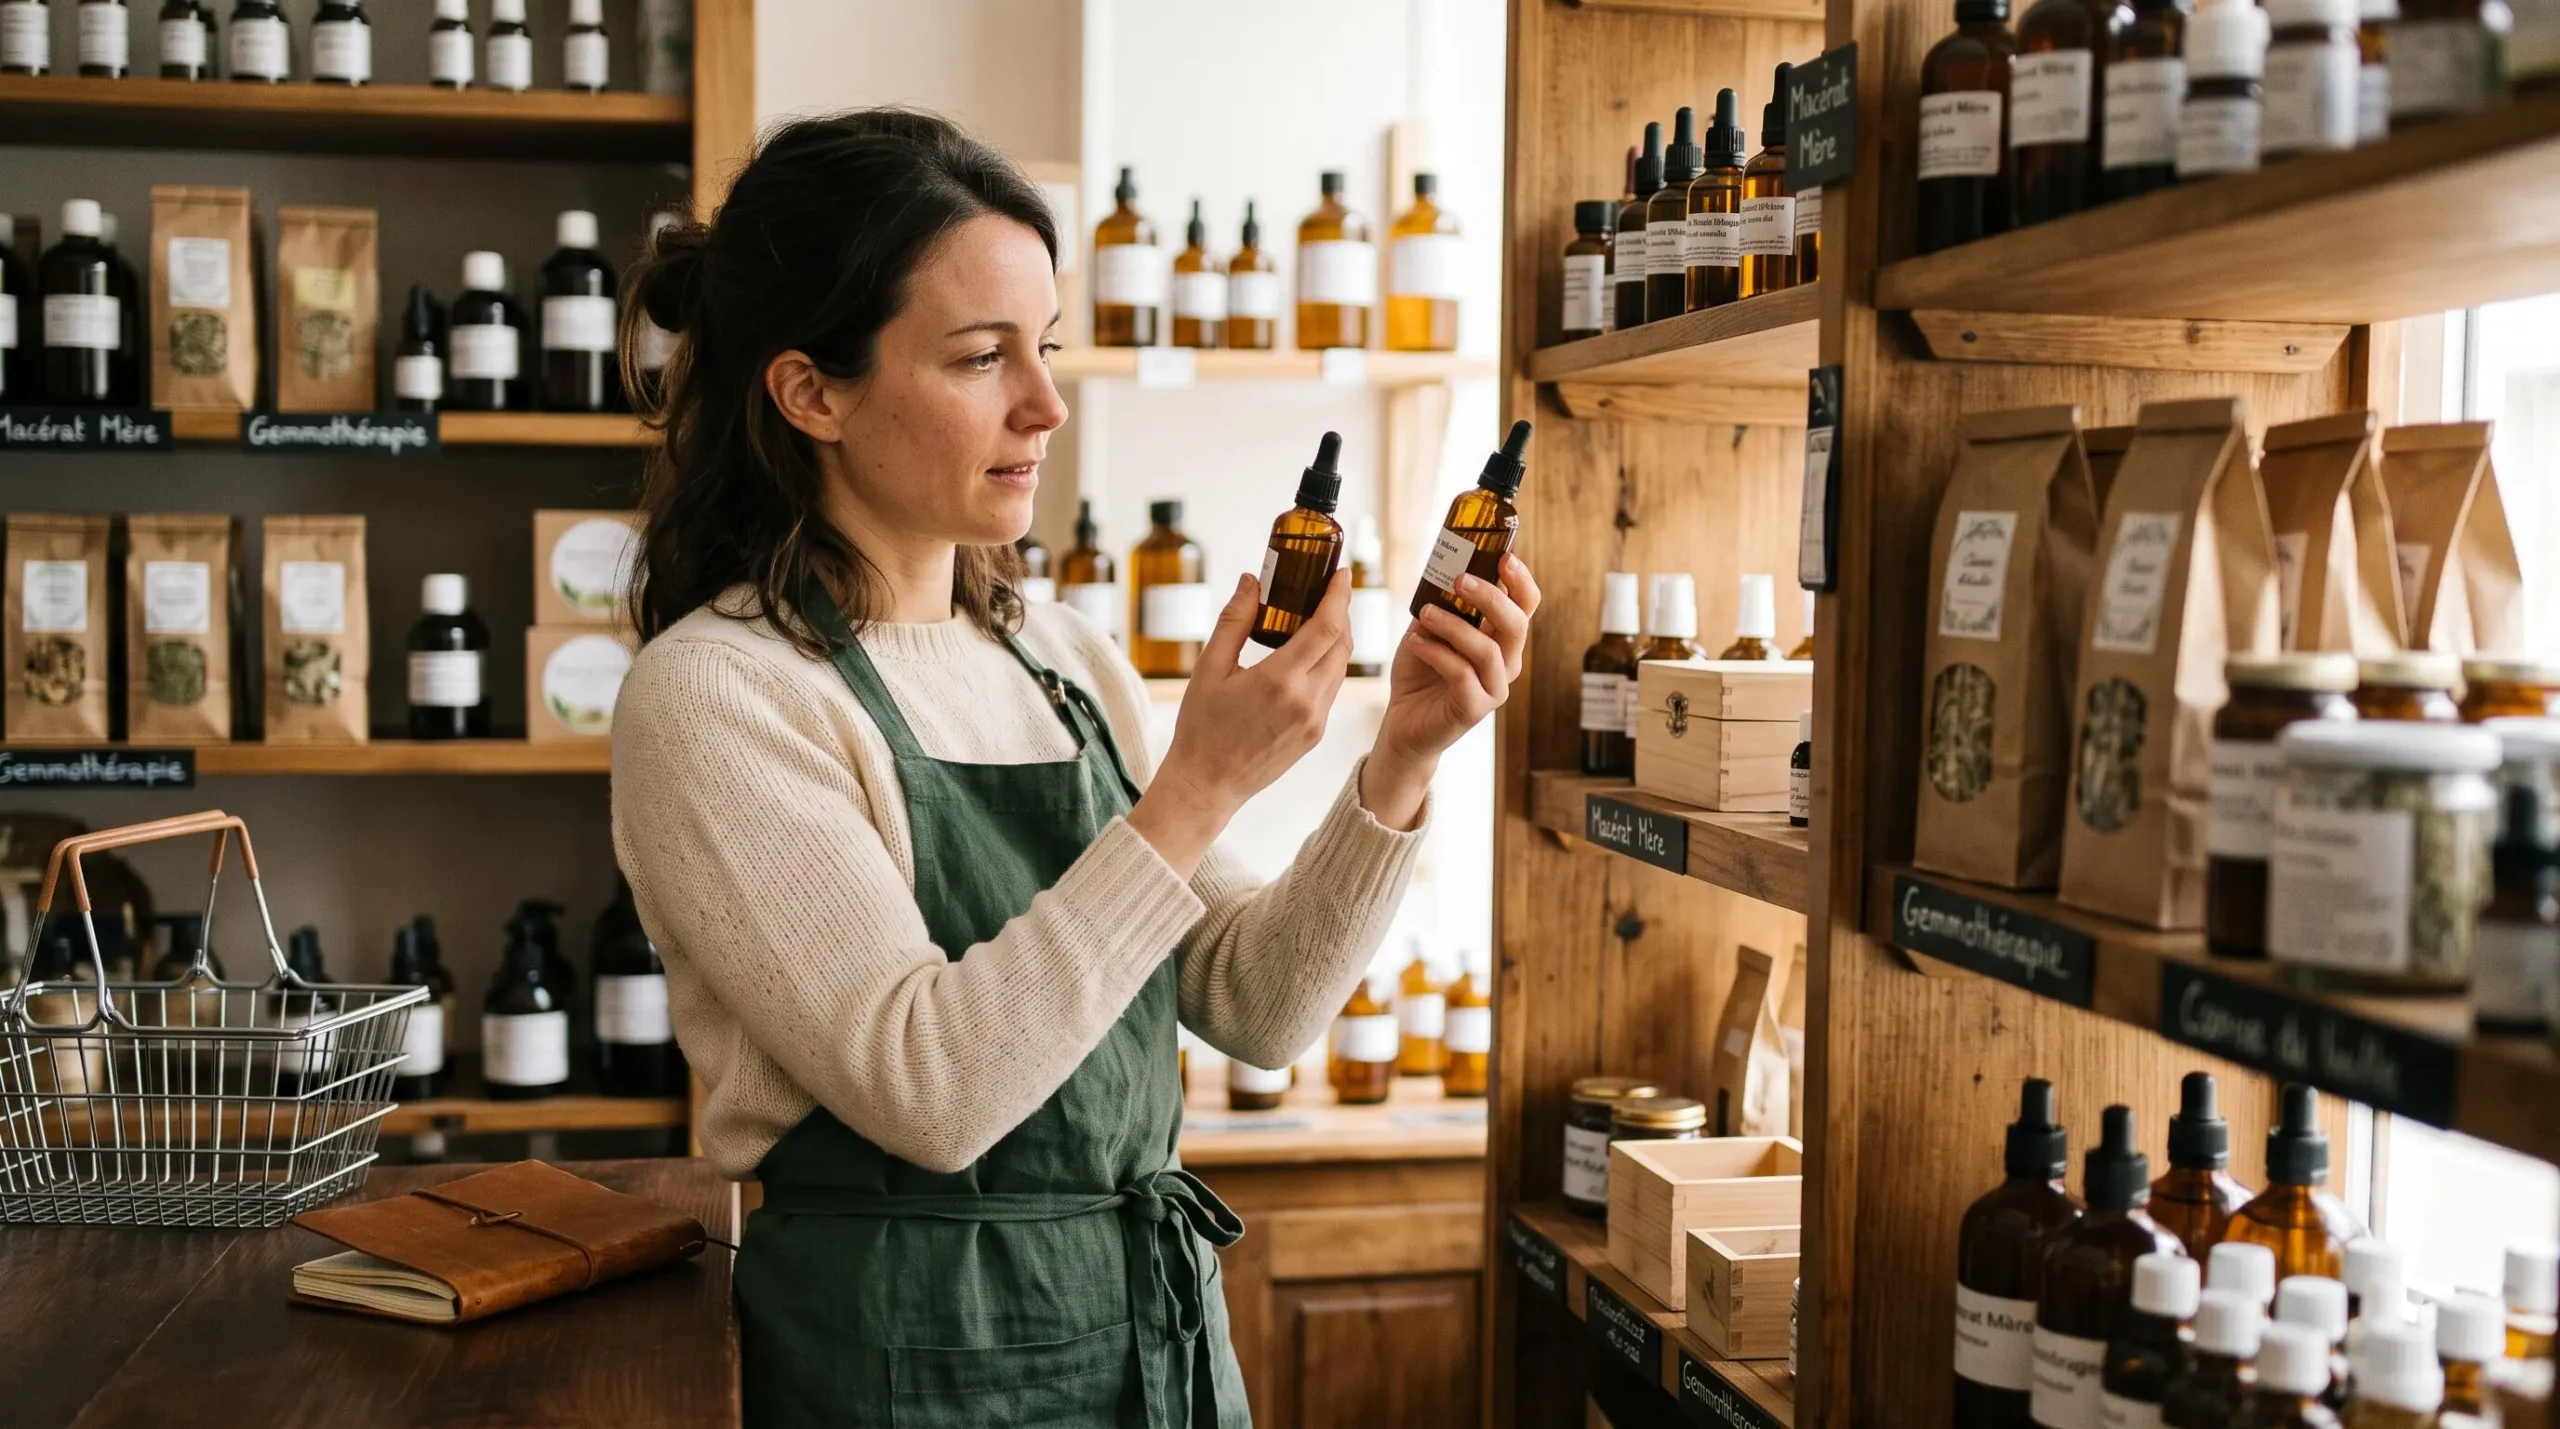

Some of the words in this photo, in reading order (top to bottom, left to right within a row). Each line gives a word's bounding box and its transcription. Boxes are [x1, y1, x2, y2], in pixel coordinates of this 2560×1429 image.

[1799, 128, 1837, 170] Mère
[100, 414, 159, 444] Mère
[248, 415, 429, 455] Gemmothérapie
[0, 752, 186, 787] Gemmothérapie
[1592, 804, 1632, 847] Macérat
[1638, 816, 1666, 856] Mère
